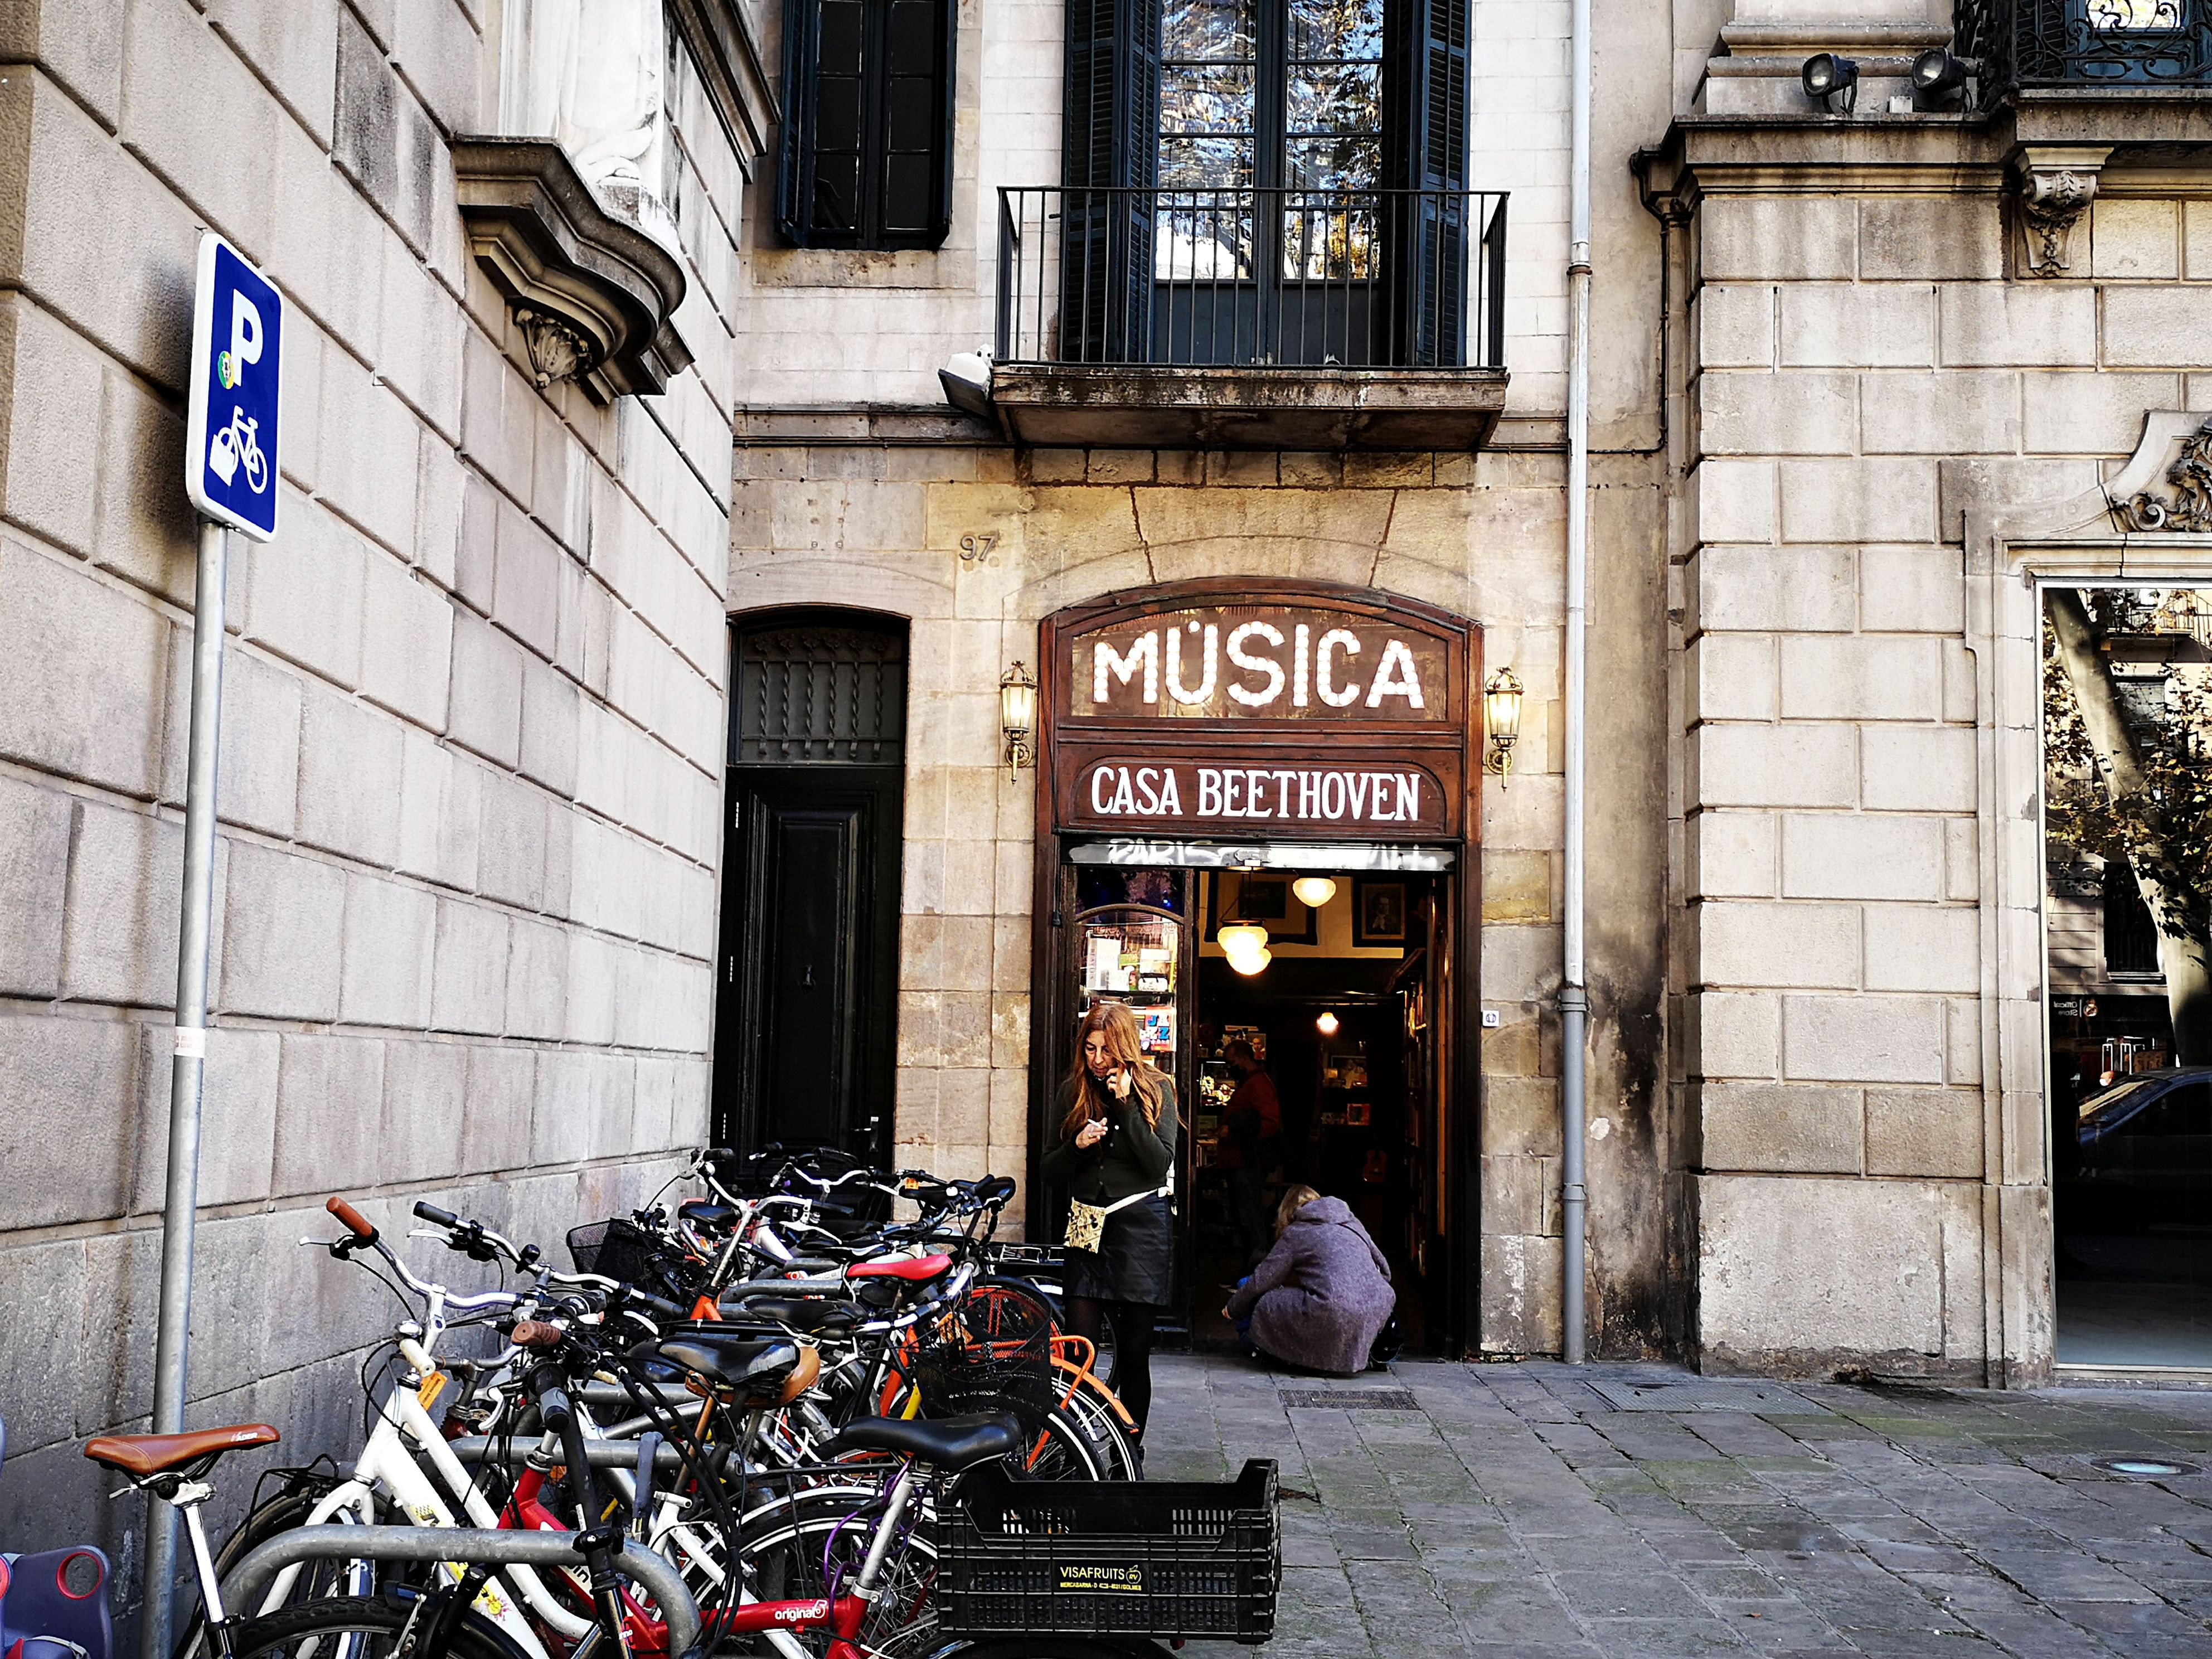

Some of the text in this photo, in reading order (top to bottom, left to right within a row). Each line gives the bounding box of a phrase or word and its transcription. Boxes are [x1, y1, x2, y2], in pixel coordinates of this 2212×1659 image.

[230, 288, 264, 386] P
[959, 535, 996, 561] 97
[1093, 620, 1424, 709] MÚSICA
[1092, 766, 1420, 821] CASA BEETHOVEN
[1060, 1566, 1125, 1580] VISAFRUITS
[775, 1607, 815, 1622] original
